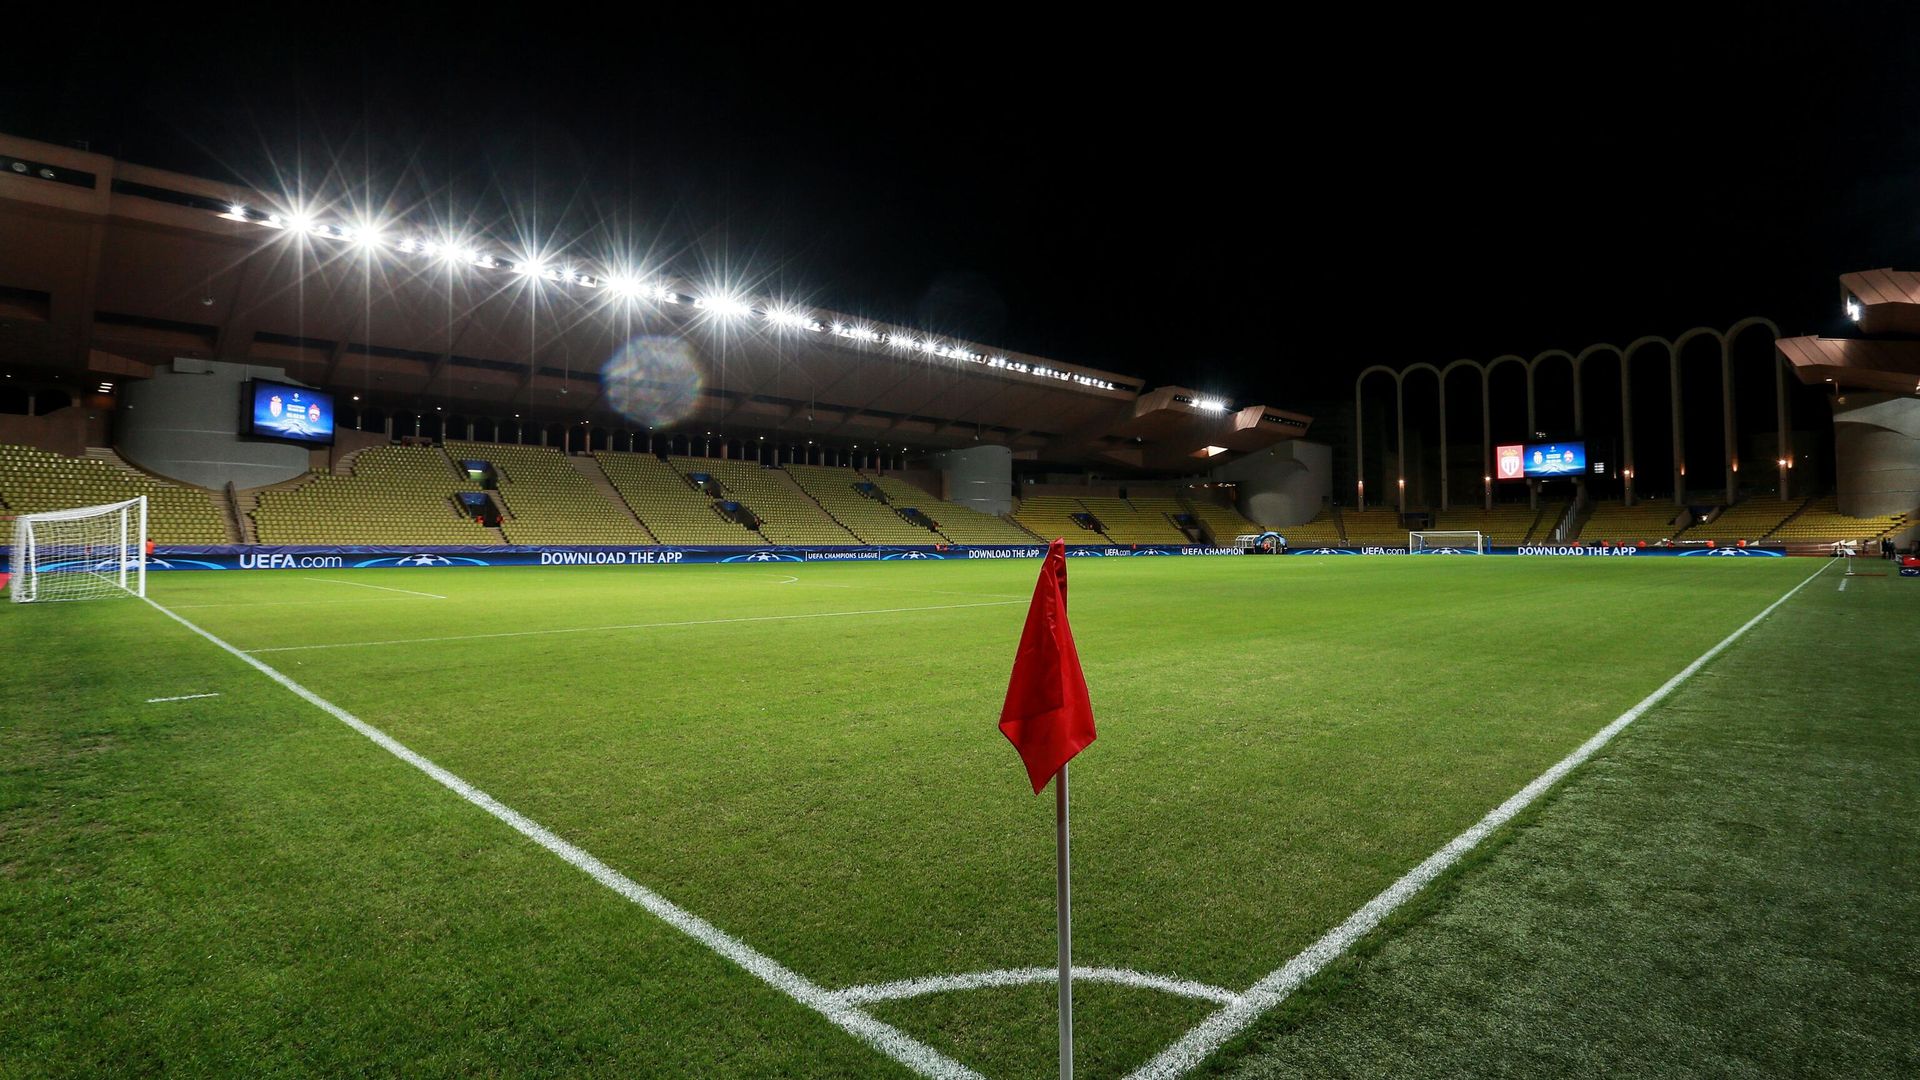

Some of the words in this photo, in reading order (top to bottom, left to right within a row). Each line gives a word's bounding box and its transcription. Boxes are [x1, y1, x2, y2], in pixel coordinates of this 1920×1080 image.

[808, 552, 824, 560] UEFA
[824, 552, 857, 560] CHAMPIONS
[968, 550, 1011, 559] DOWNLOAD
[1012, 549, 1025, 558] THE
[1026, 549, 1040, 558] APP
[1104, 548, 1131, 556] UEFA.com
[1182, 547, 1203, 555] UEFA
[1361, 546, 1406, 556] UEFA.com
[1517, 546, 1584, 556] DOWNLOAD
[1586, 546, 1610, 556] THE
[1612, 546, 1637, 556] APP
[239, 553, 343, 569] UEFA.com
[540, 552, 626, 565] DOWNLOAD
[629, 551, 655, 564] THE
[657, 551, 683, 564] APP
